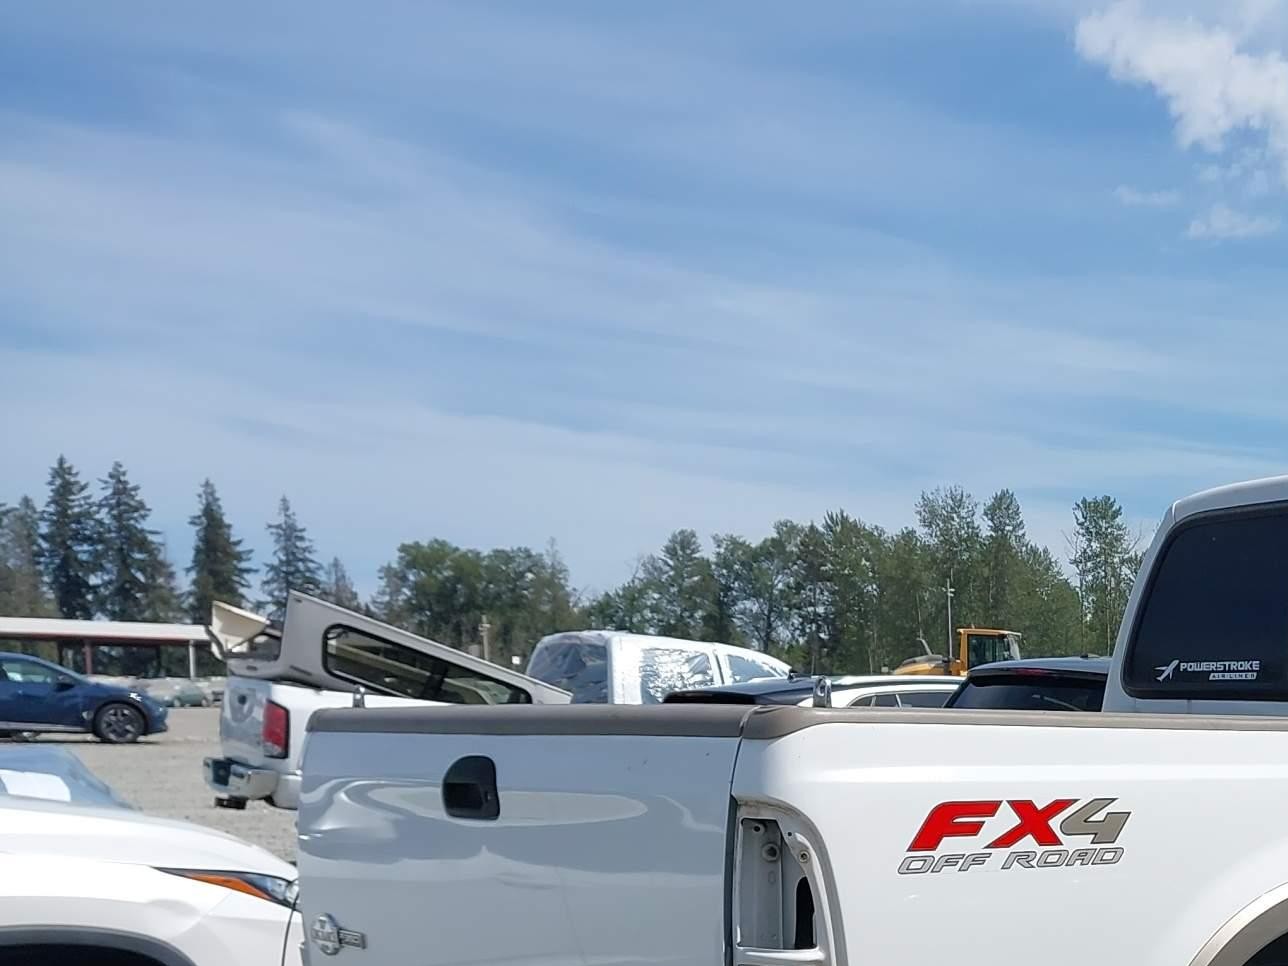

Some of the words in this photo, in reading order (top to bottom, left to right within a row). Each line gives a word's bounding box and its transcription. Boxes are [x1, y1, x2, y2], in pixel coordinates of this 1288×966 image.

[1180, 661, 1260, 671] POWERSTROKE
[906, 797, 1132, 852] FX4
[897, 852, 992, 875] OFF
[1001, 846, 1124, 870] ROAD
